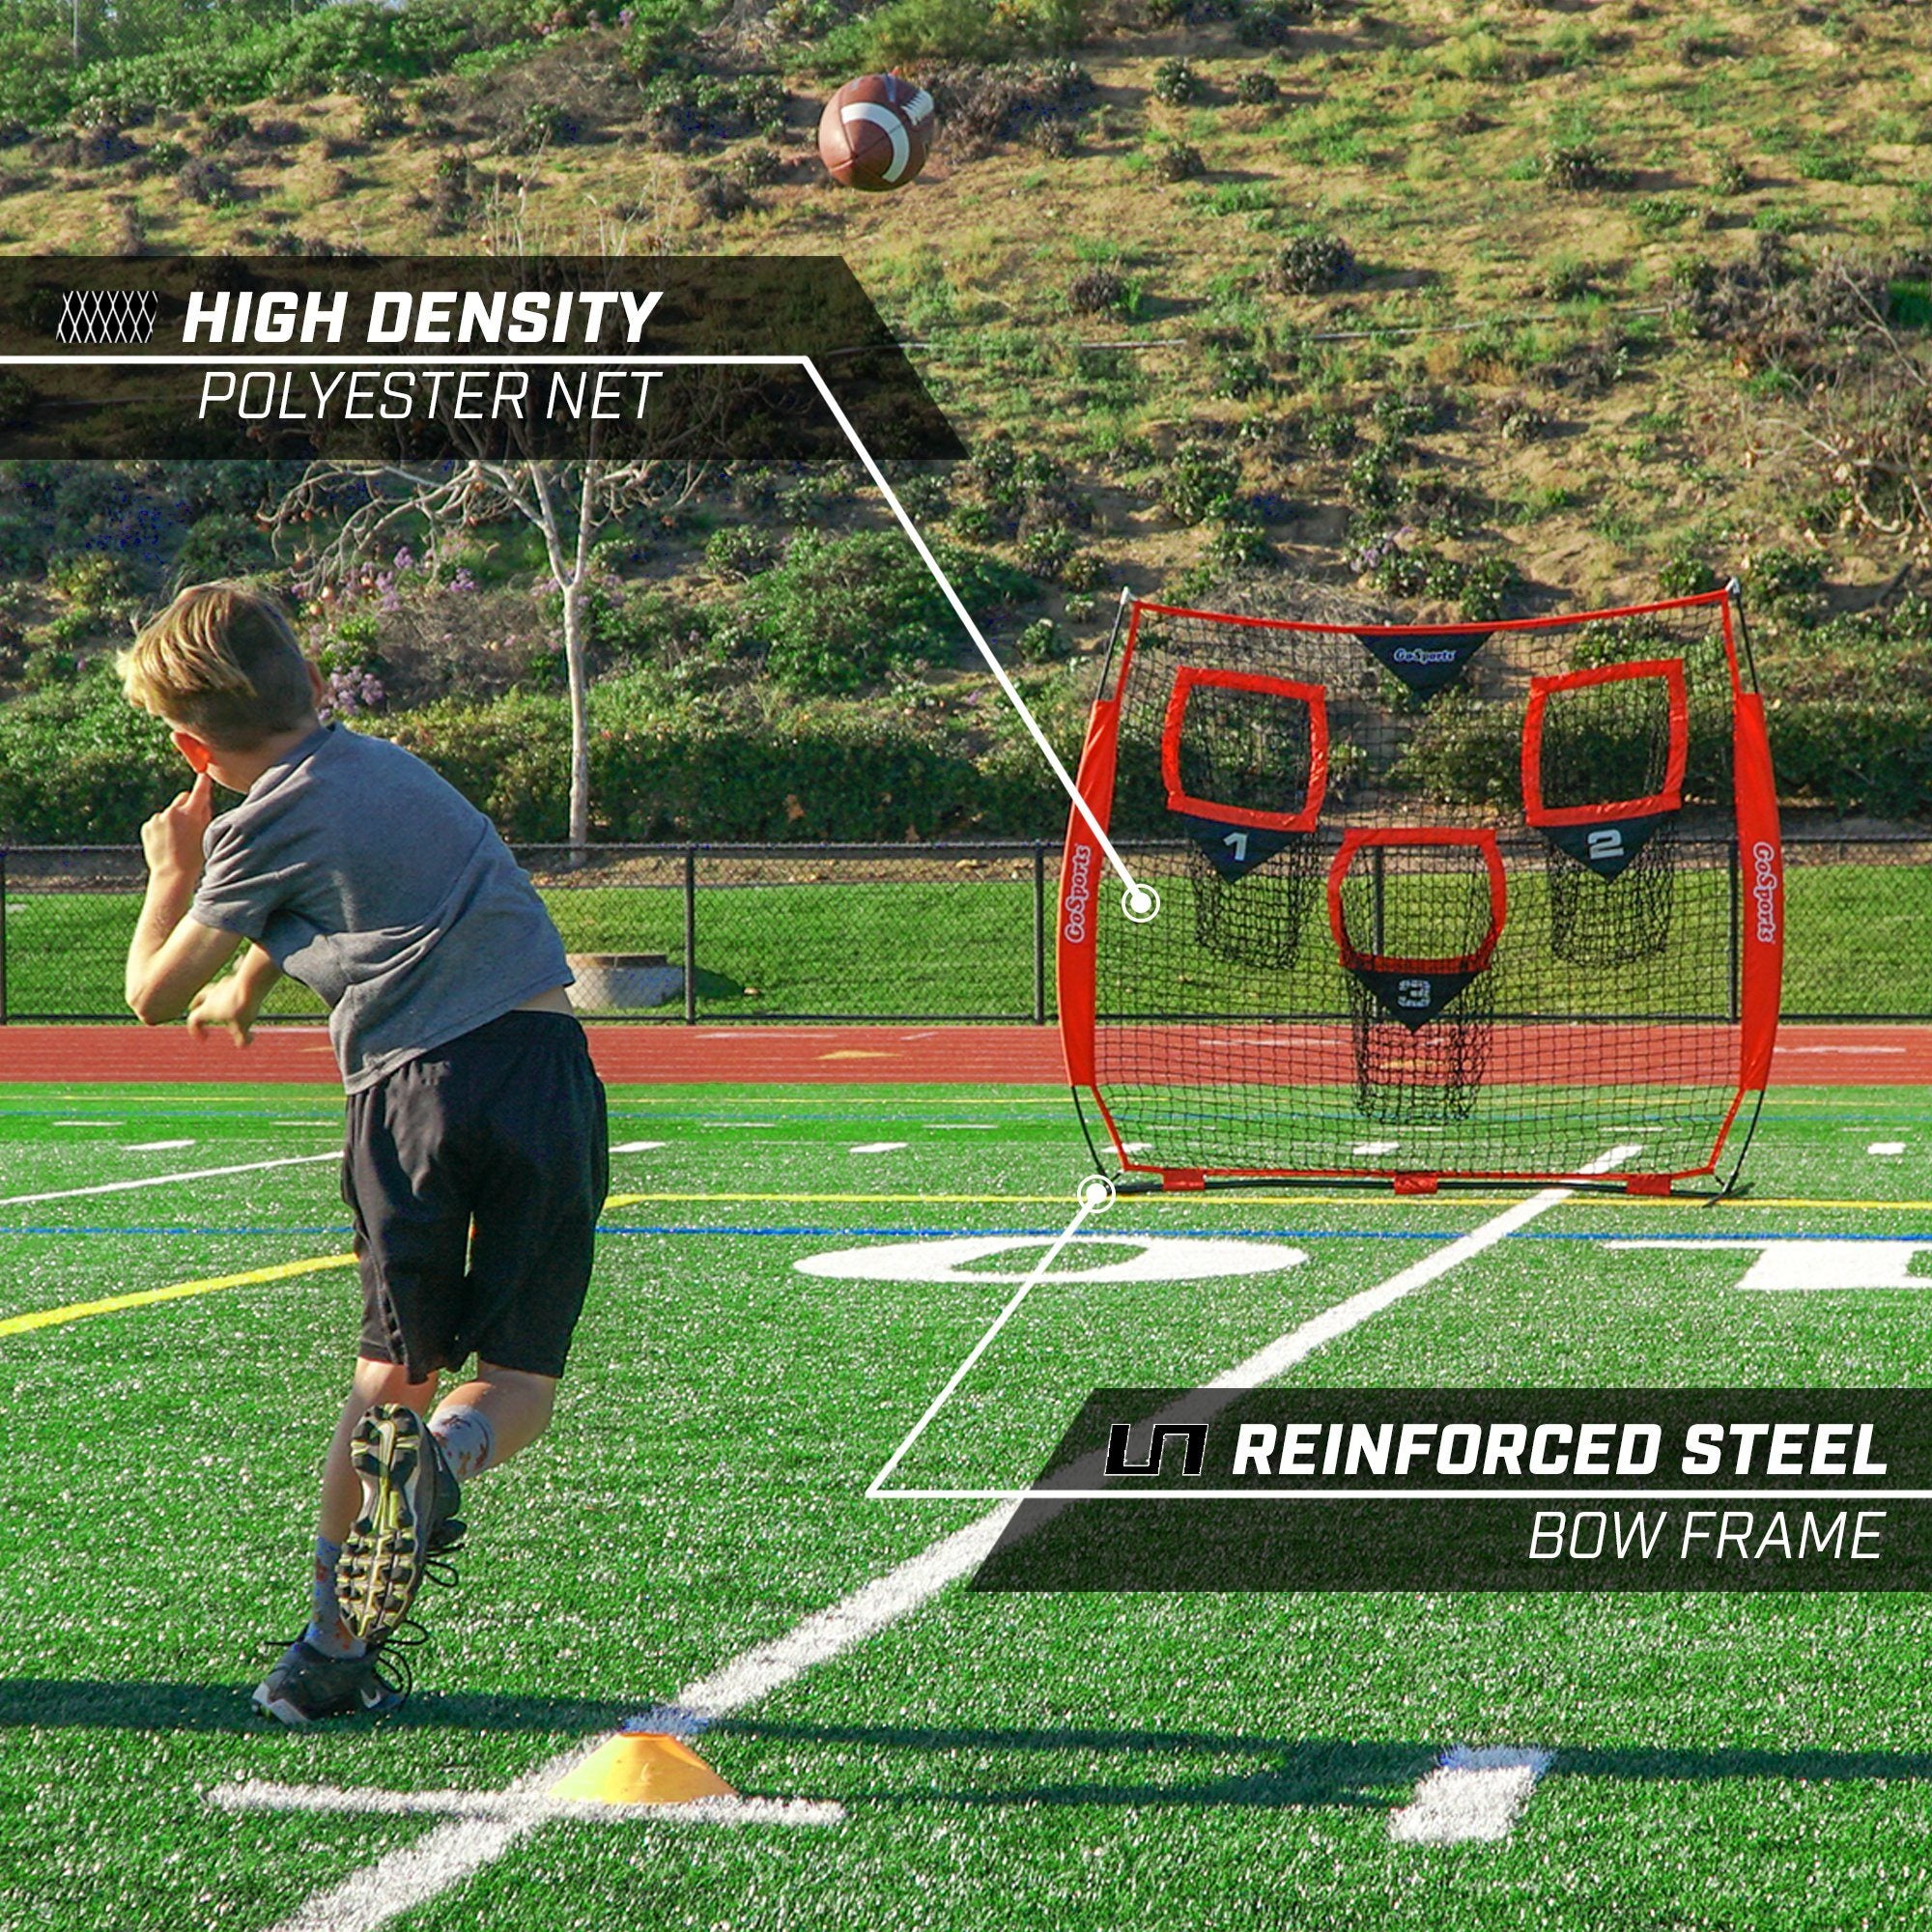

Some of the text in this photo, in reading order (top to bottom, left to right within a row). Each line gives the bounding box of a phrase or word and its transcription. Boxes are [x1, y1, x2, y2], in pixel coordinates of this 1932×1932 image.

[1393, 647, 1457, 665] GoSports
[1223, 832, 1248, 861] 1
[1587, 829, 1625, 860] 2
[1064, 844, 1092, 944] GoSports
[1753, 841, 1777, 943] GoSports
[1397, 979, 1432, 1008] 3
